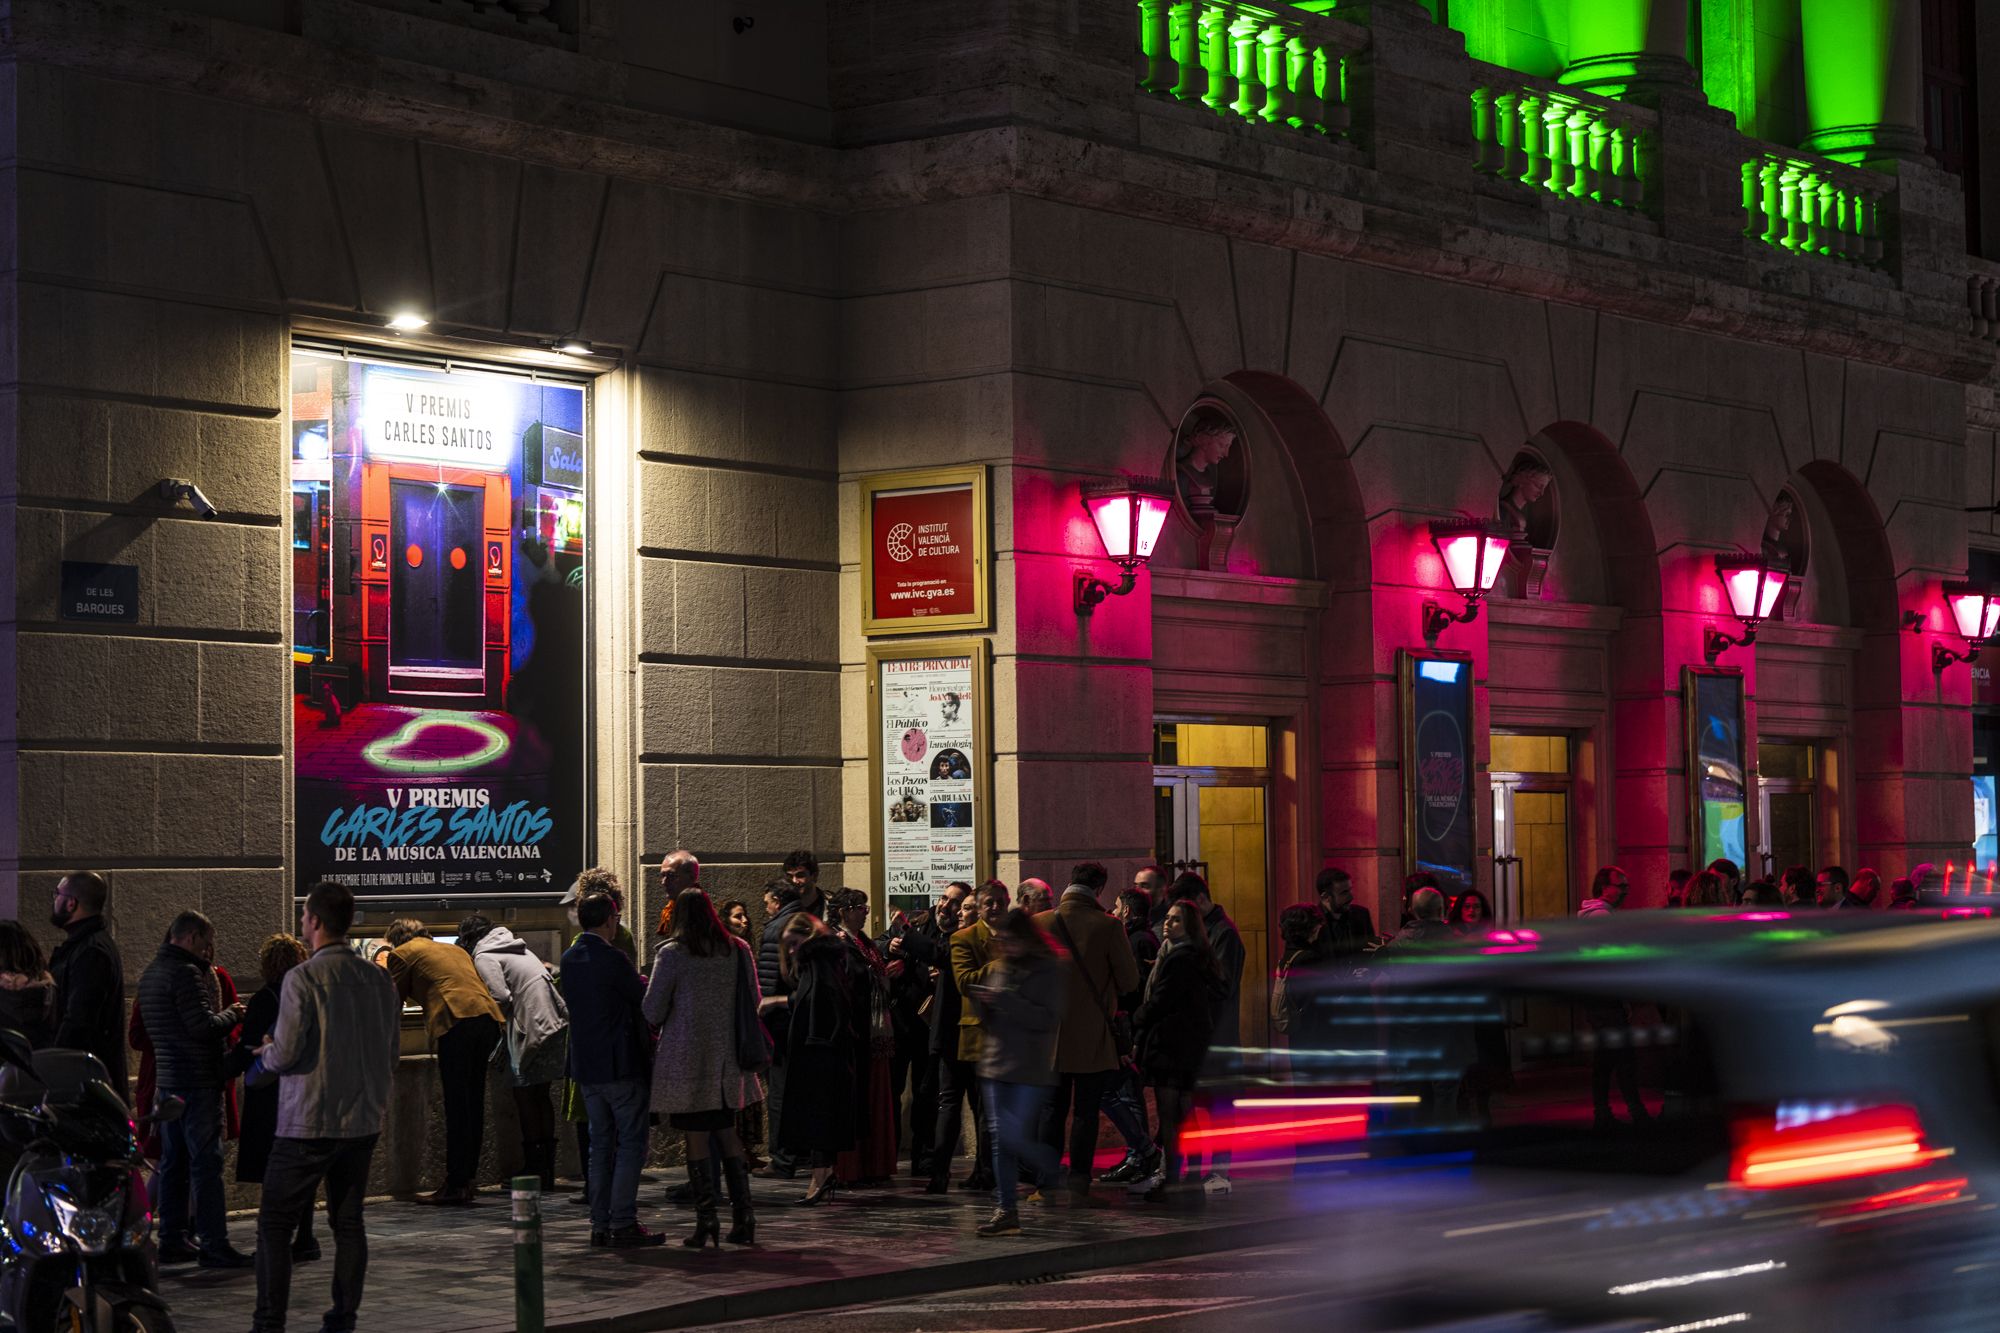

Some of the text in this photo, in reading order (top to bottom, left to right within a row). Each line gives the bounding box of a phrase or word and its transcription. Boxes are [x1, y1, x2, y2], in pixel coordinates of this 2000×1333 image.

[406, 393, 471, 419] V PREMIS
[385, 420, 492, 451] CARLES SANTOS
[918, 522, 948, 533] INSTITUT
[918, 533, 950, 545] VALENCIÀ
[918, 545, 960, 557] DE CULTURA
[86, 587, 114, 597] DE LES
[890, 588, 955, 600] www.ivc.gva.es
[76, 602, 125, 615] BARQUES
[887, 659, 972, 672] TEATRE PRINCIPAL
[895, 718, 928, 728] Público
[887, 776, 901, 786] Los
[902, 776, 928, 785] Pazos
[887, 787, 897, 796] de
[387, 788, 490, 809] V PREMIS
[320, 800, 553, 848] CARLES SANTOS
[335, 843, 541, 861] DE LA MÚSICA VALENCIANA
[931, 863, 947, 871] Dani
[361, 873, 378, 886] TEATRE
[379, 873, 404, 885] PRINCIPAL
[405, 872, 411, 885] DE
[888, 871, 899, 881] La
[888, 885, 898, 893] es
